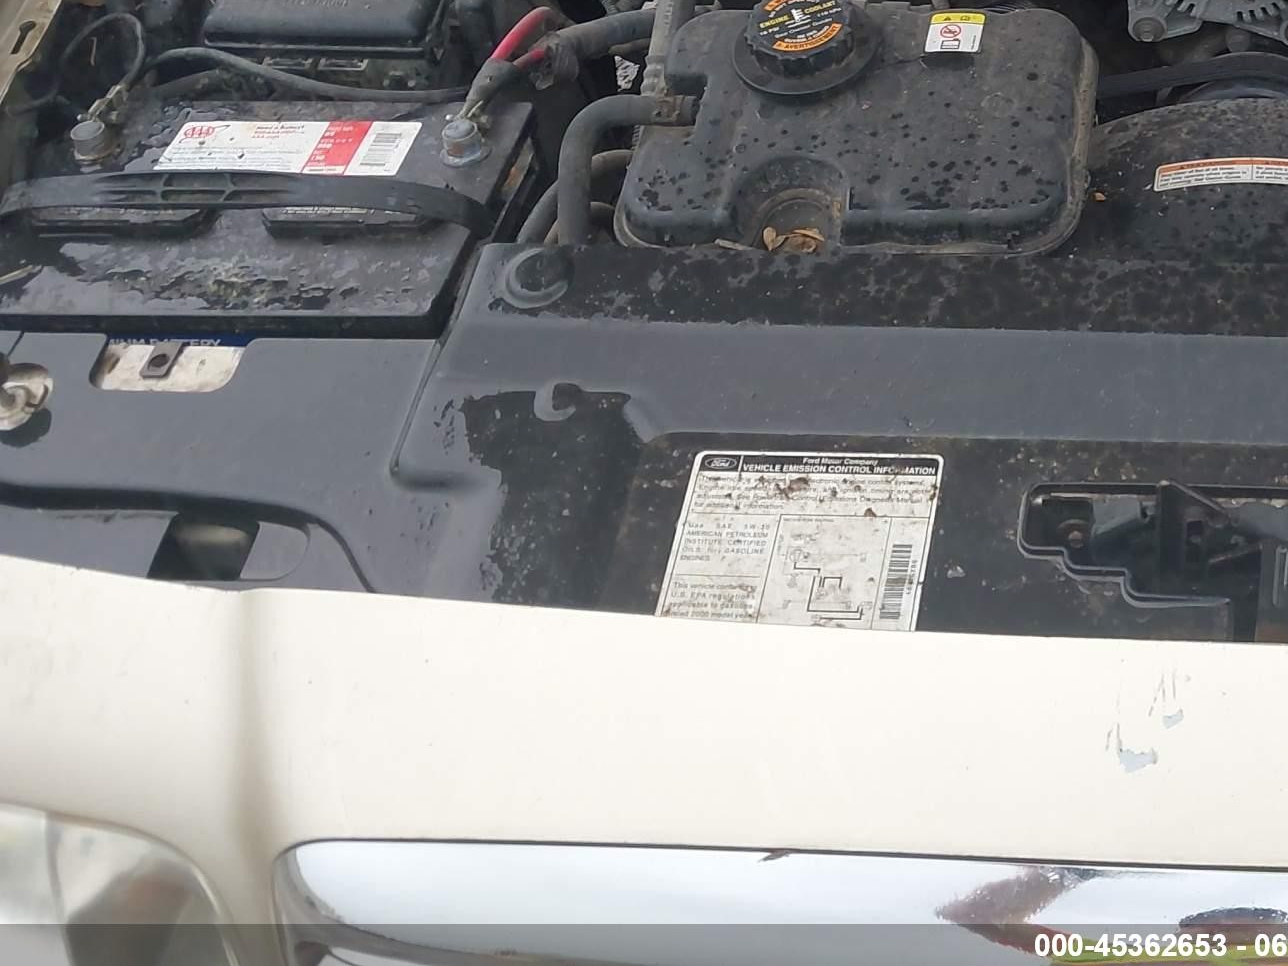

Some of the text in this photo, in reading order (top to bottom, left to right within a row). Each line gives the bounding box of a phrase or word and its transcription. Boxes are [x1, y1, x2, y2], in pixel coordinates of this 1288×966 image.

[759, 14, 790, 29] ENGINE
[804, 0, 837, 15] COOLANT
[802, 457, 820, 465] Ford
[844, 458, 879, 466] Company
[743, 464, 936, 475] VEHICLE EMISSION CONTROL INFOATION
